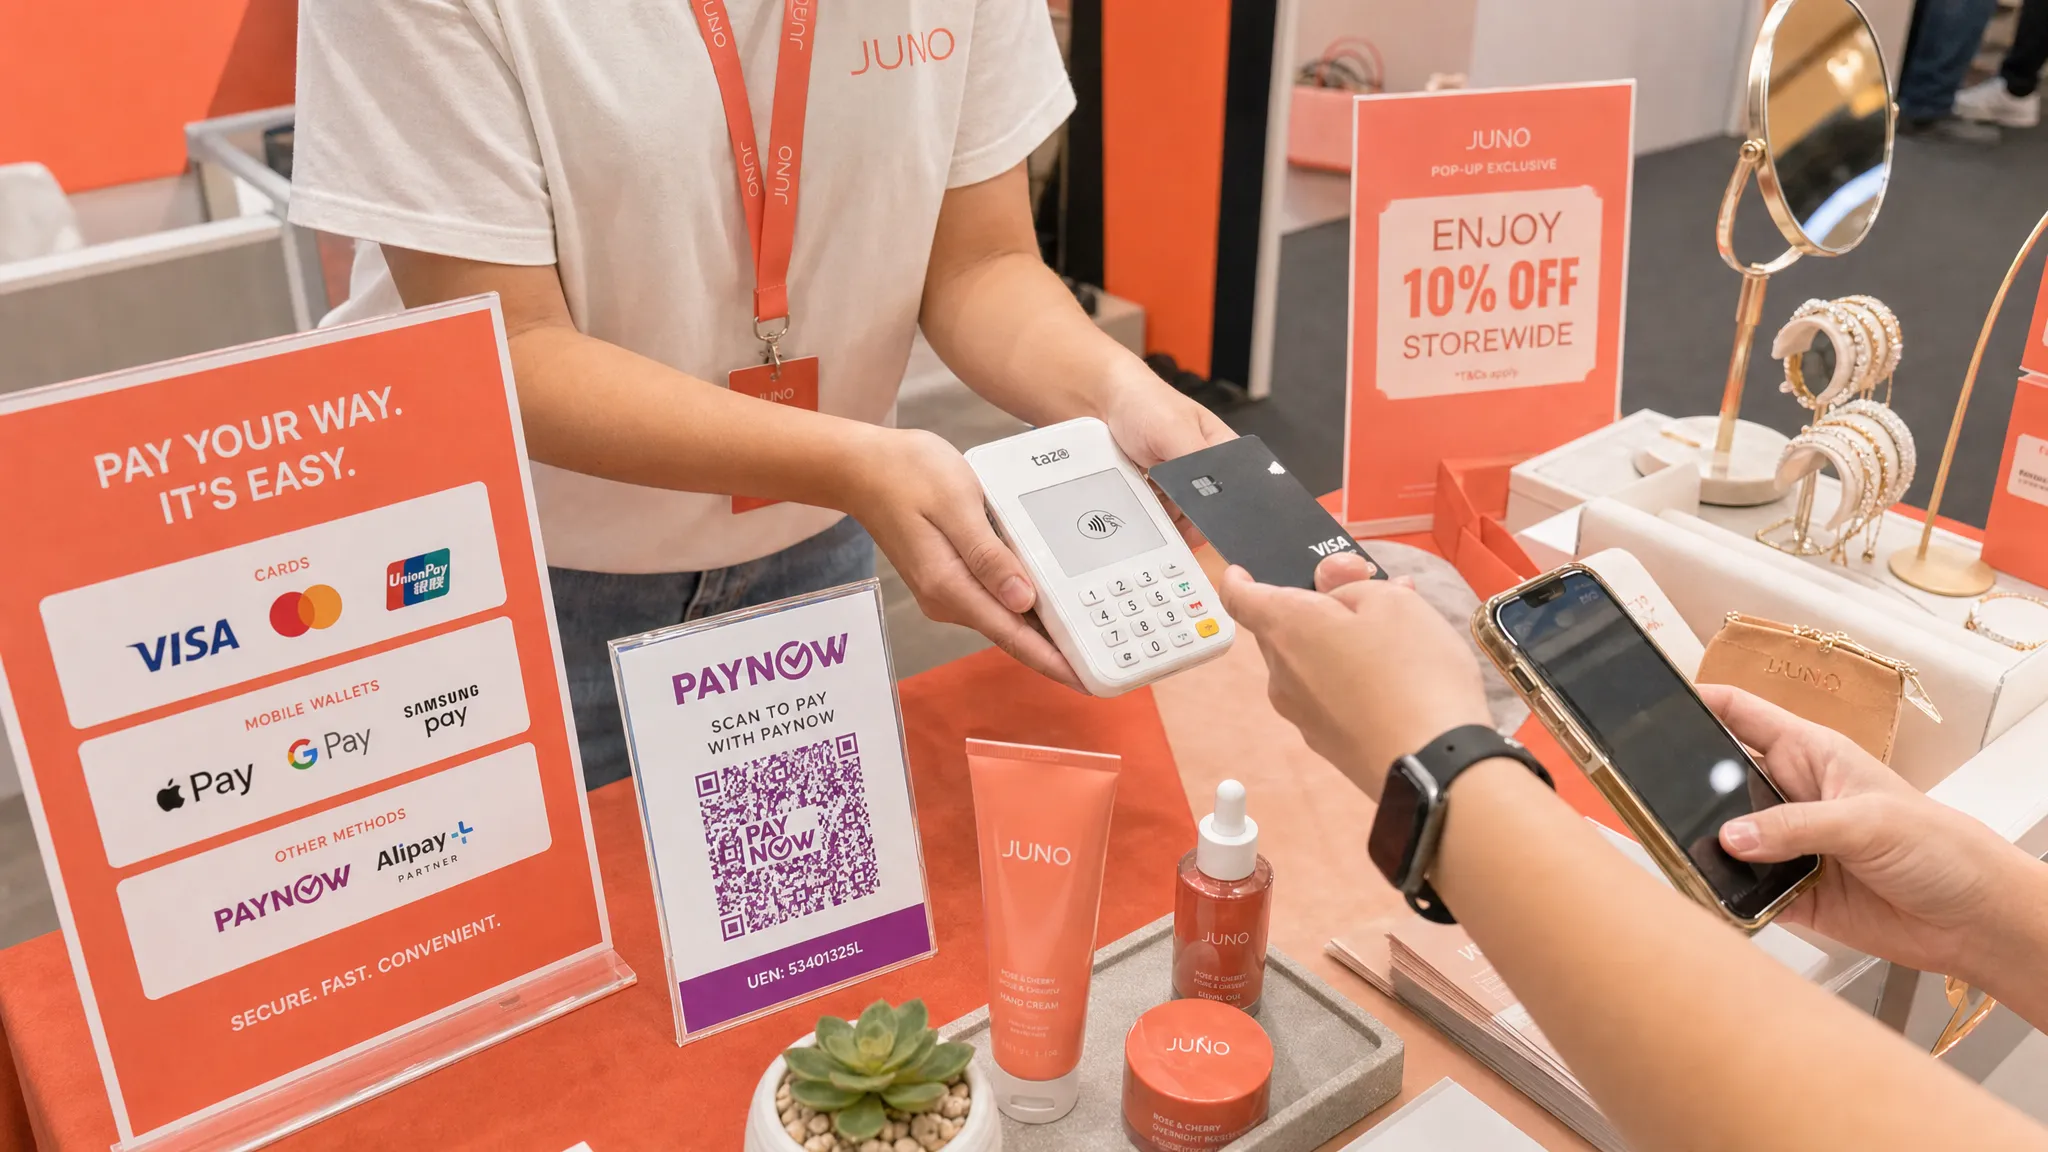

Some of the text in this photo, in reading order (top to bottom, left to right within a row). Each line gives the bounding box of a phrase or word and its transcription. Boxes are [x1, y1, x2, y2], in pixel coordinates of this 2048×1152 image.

[701, 0, 727, 48] UNO
[851, 27, 956, 76] JUNO
[1465, 127, 1531, 151] JUNO
[740, 141, 759, 197] JUNO
[774, 145, 793, 205] JUNO
[1431, 158, 1557, 177] POP-UP EXCLUSIVE
[1432, 211, 1563, 252] ENJOY
[1403, 256, 1580, 319] 10% OFF
[1402, 322, 1574, 360] STOREWIDE
[94, 386, 403, 489] PAY YOUR WAY.
[160, 448, 357, 525] IT'S EASY.
[1308, 536, 1352, 557] VISA
[254, 556, 311, 582] CARDS
[389, 563, 448, 587] UnionPay
[1088, 571, 1152, 601] 1 2 3
[1101, 590, 1164, 622] 4 5 6
[1110, 610, 1176, 642] 7 8 9
[126, 619, 241, 673] VISA
[1151, 640, 1161, 653] 0
[671, 633, 849, 706] PAYNOW
[245, 679, 381, 731] MOBILE WALLETS
[403, 684, 479, 719] SAMSUNG
[710, 691, 828, 734] SCAN TO PAY
[424, 704, 468, 737] pay
[707, 709, 836, 755] WITH PAYNOW
[324, 729, 372, 760] Pay
[190, 763, 255, 802] Pay
[274, 807, 408, 863] OTHER METHODS
[745, 815, 789, 846] PAY
[749, 829, 816, 865] NOW
[397, 853, 459, 883] PARTNER
[1001, 840, 1072, 867] JUNO
[213, 863, 352, 933] PAYNOW
[1201, 931, 1250, 946] JUNO
[230, 913, 502, 1033] SECURE. FAST. CONVENIENT.
[747, 940, 864, 990] UEN: 53401325L
[999, 992, 1059, 1010] HAND CREAM
[1166, 1036, 1231, 1057] JUNO
